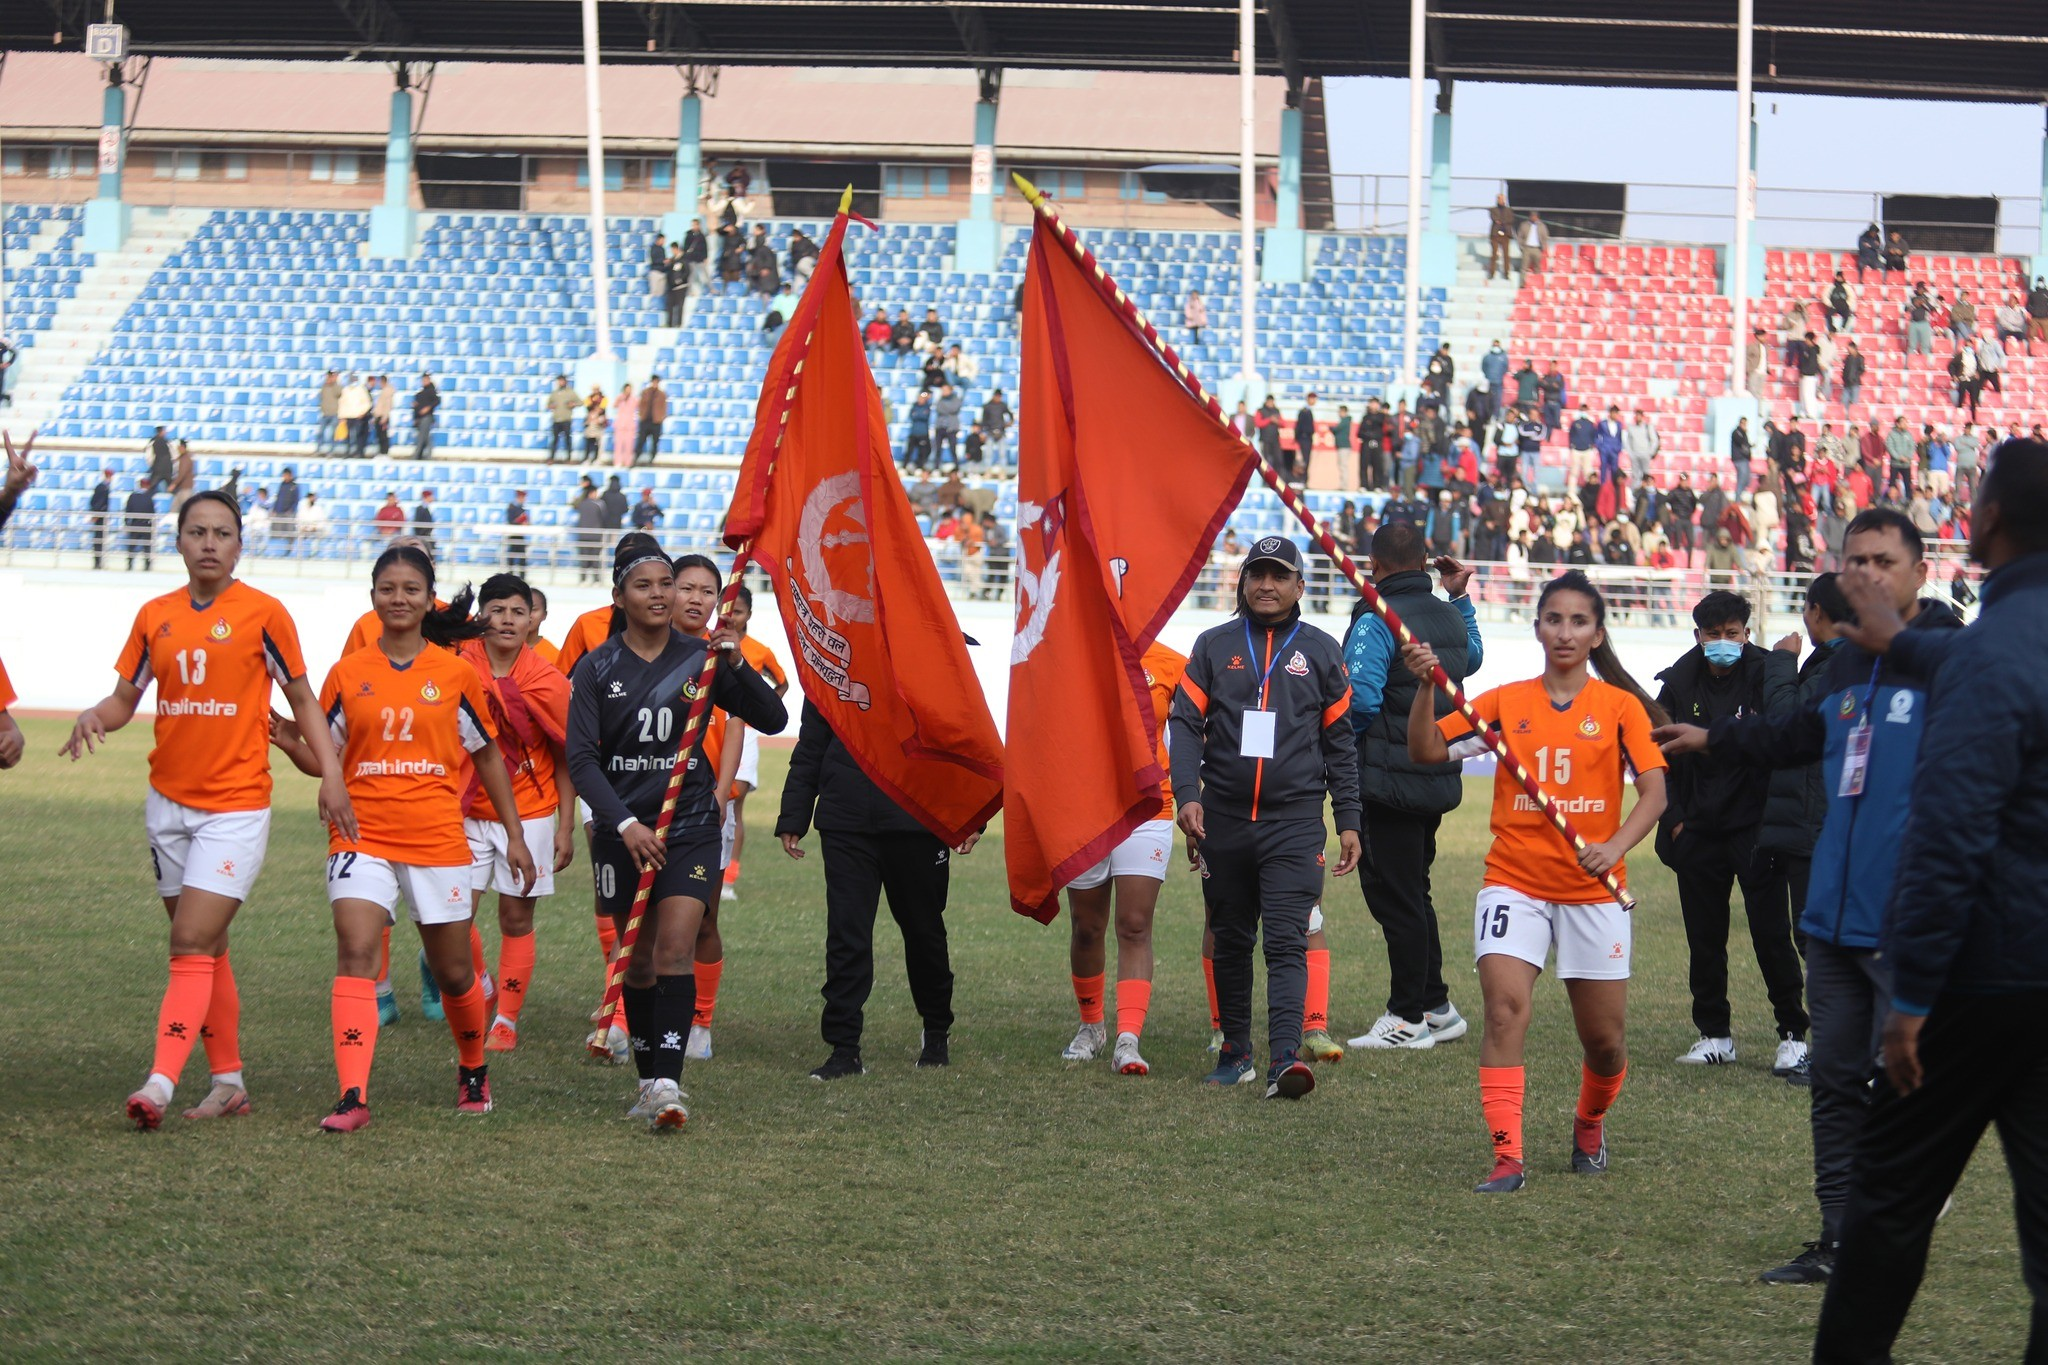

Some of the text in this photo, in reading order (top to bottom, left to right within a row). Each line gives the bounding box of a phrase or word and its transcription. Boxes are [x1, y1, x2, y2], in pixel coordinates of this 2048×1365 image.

[98, 37, 113, 53] D
[176, 648, 207, 685] 13
[607, 691, 627, 699] KELME
[381, 706, 415, 742] 22
[638, 706, 673, 742] 20
[608, 754, 698, 772] Mahinda
[1535, 746, 1571, 785] 15
[688, 873, 708, 882] KELME
[1480, 904, 1511, 941] 15
